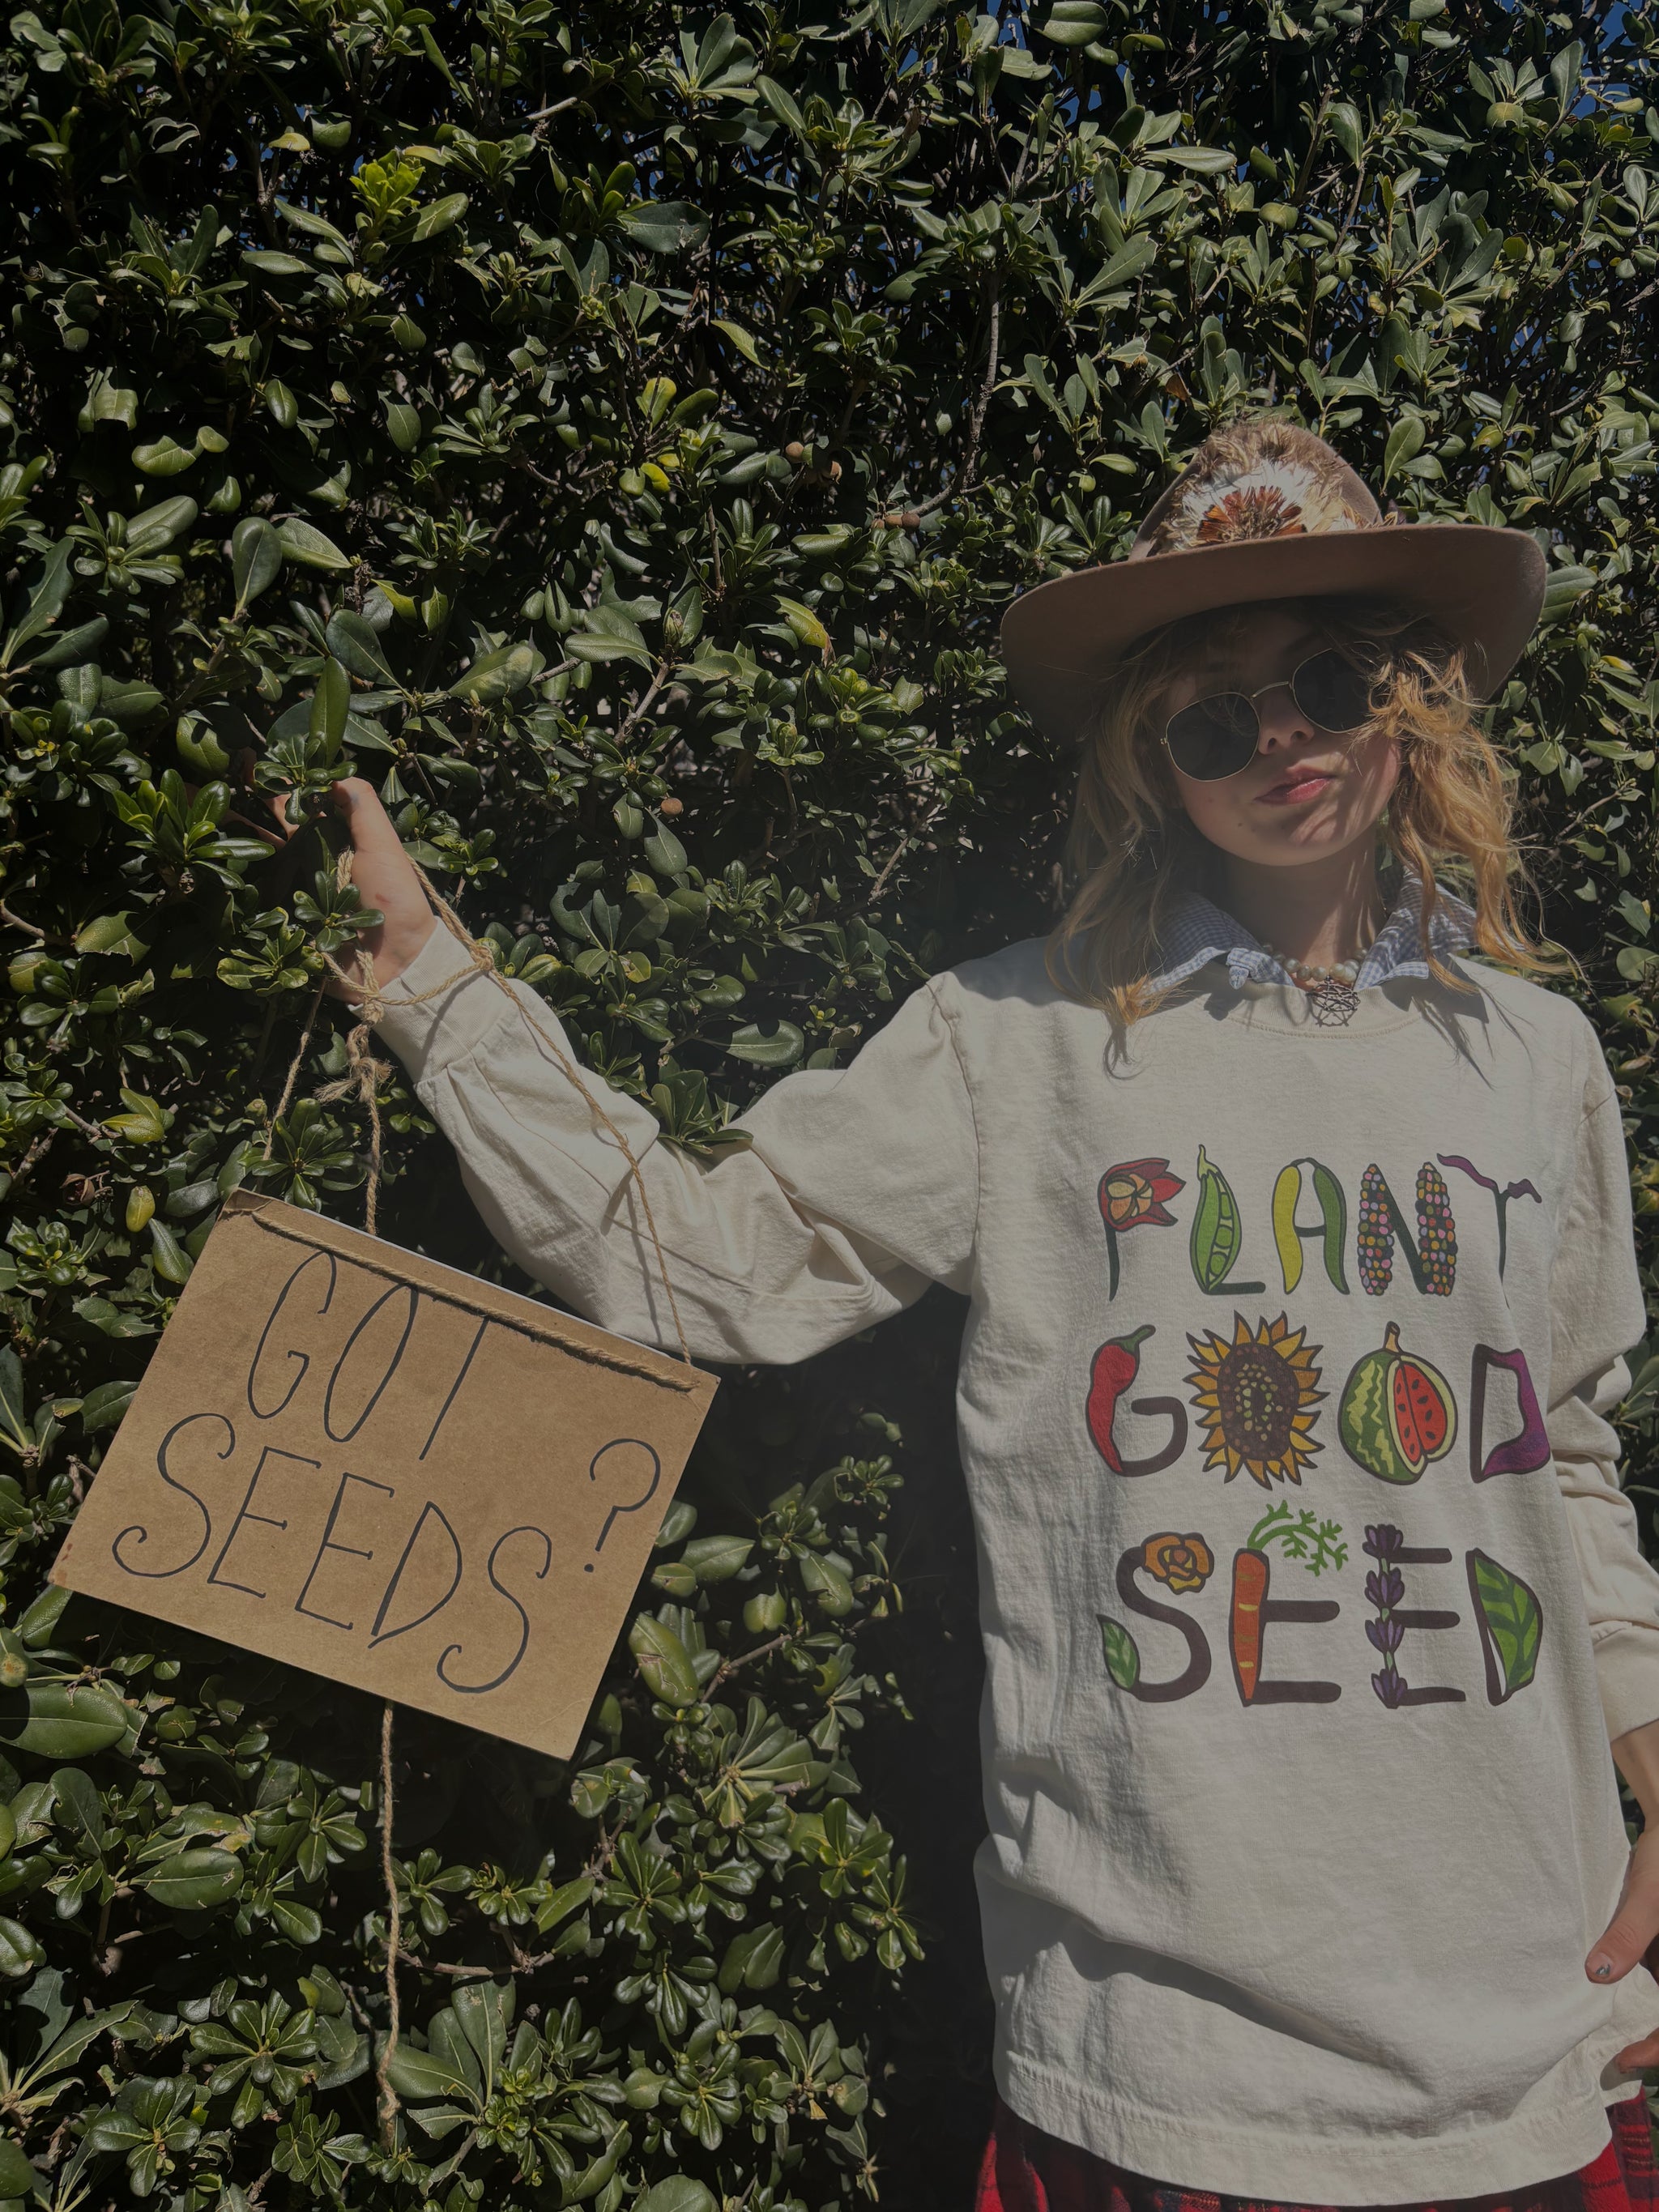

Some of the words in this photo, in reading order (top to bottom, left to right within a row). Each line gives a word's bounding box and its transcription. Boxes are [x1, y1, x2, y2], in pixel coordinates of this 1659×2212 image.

[1098, 1144, 1542, 1308] PLANT
[1085, 1311, 1550, 1490] GOOD
[1096, 1500, 1543, 1709] SEED
